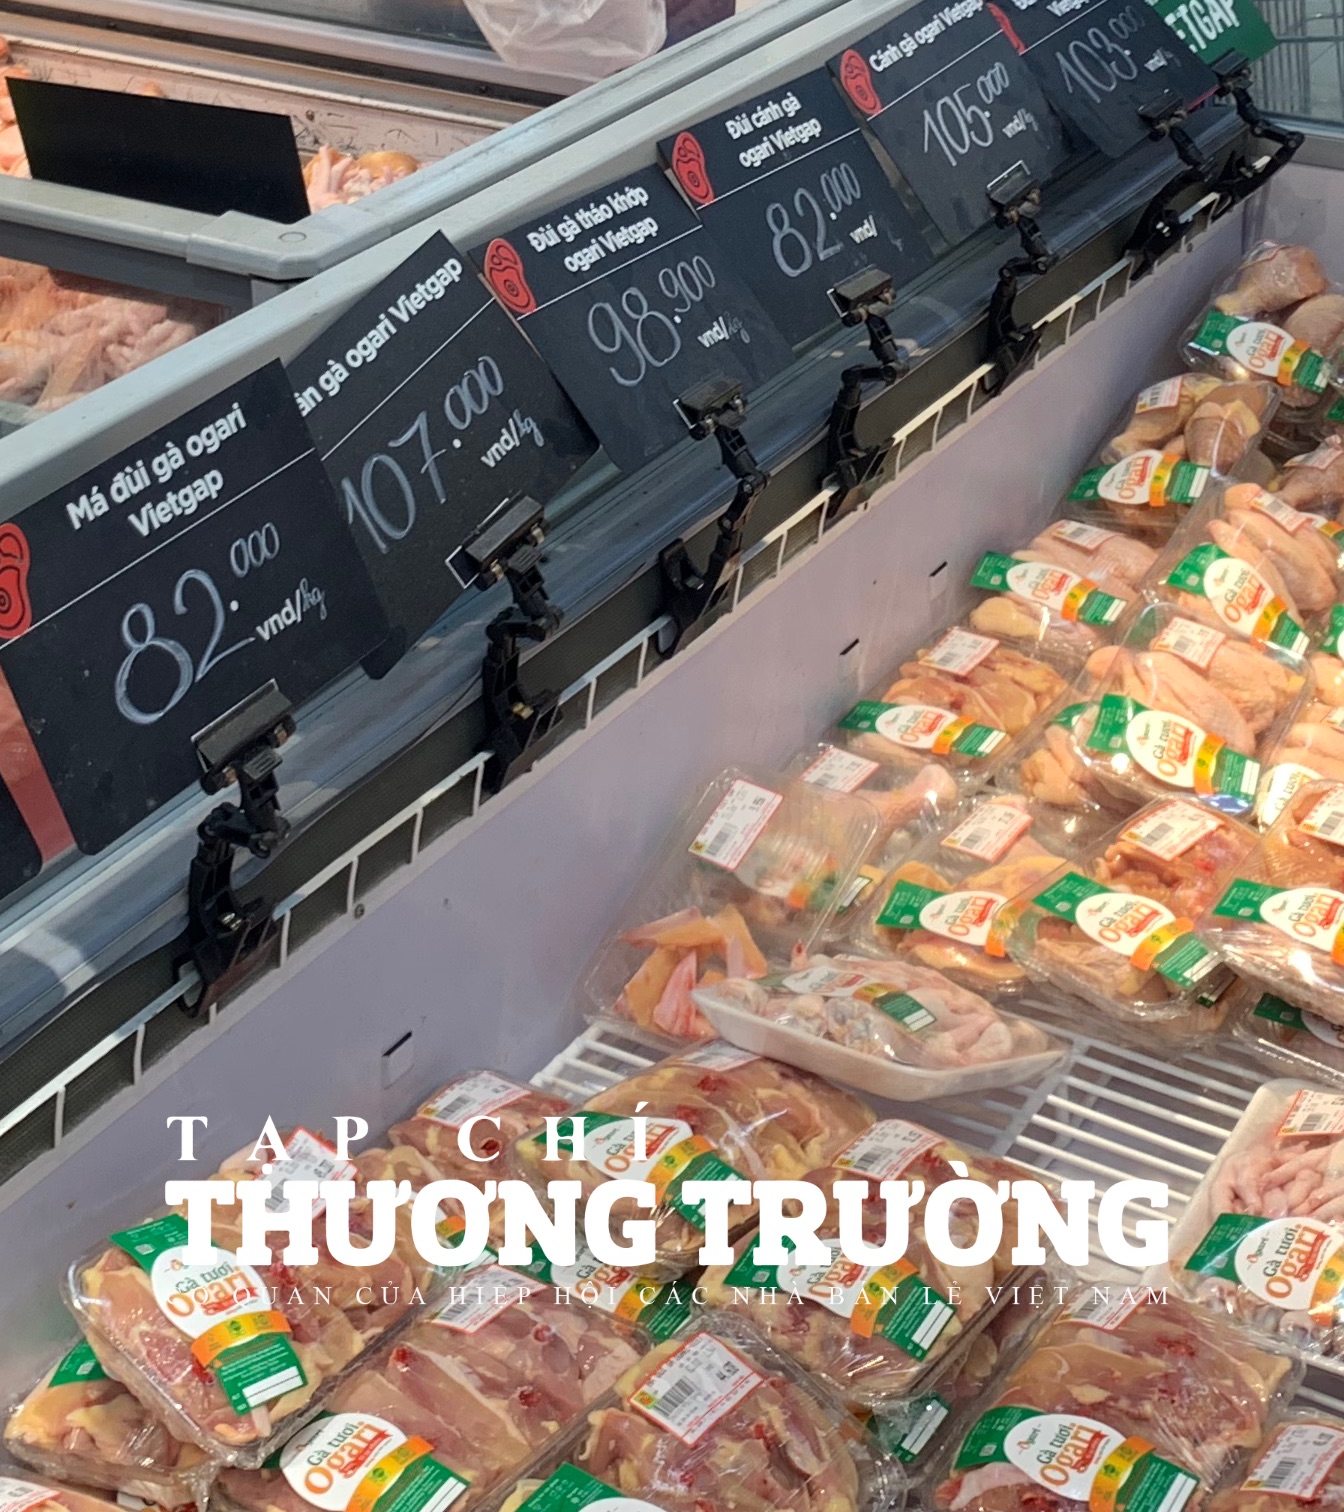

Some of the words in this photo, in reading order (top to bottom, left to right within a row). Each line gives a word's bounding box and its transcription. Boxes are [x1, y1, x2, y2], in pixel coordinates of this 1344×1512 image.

[868, 43, 903, 73] Cánh
[898, 32, 918, 58] gà
[914, 14, 947, 45] ogari
[725, 112, 754, 140] Đùi
[751, 99, 785, 129] cánh
[781, 91, 802, 118] gà
[738, 135, 776, 168] ogari
[768, 117, 822, 152] Vietgap
[923, 61, 1010, 166] 105.000
[526, 223, 561, 253] Đùi
[556, 214, 582, 243] gà
[574, 201, 614, 234] tháo
[606, 186, 650, 216] khớp
[563, 237, 607, 272] ogari
[597, 216, 659, 253] Vietgap
[766, 162, 861, 278] 82.000
[318, 359, 350, 398] gà
[345, 312, 397, 370] ogari
[388, 256, 463, 331] Vietgap
[65, 485, 111, 530] Má
[108, 458, 148, 507] đùi
[150, 438, 186, 486] gà
[184, 403, 247, 465] ogari
[127, 466, 225, 539] Vietgap
[114, 522, 282, 725] 82.000
